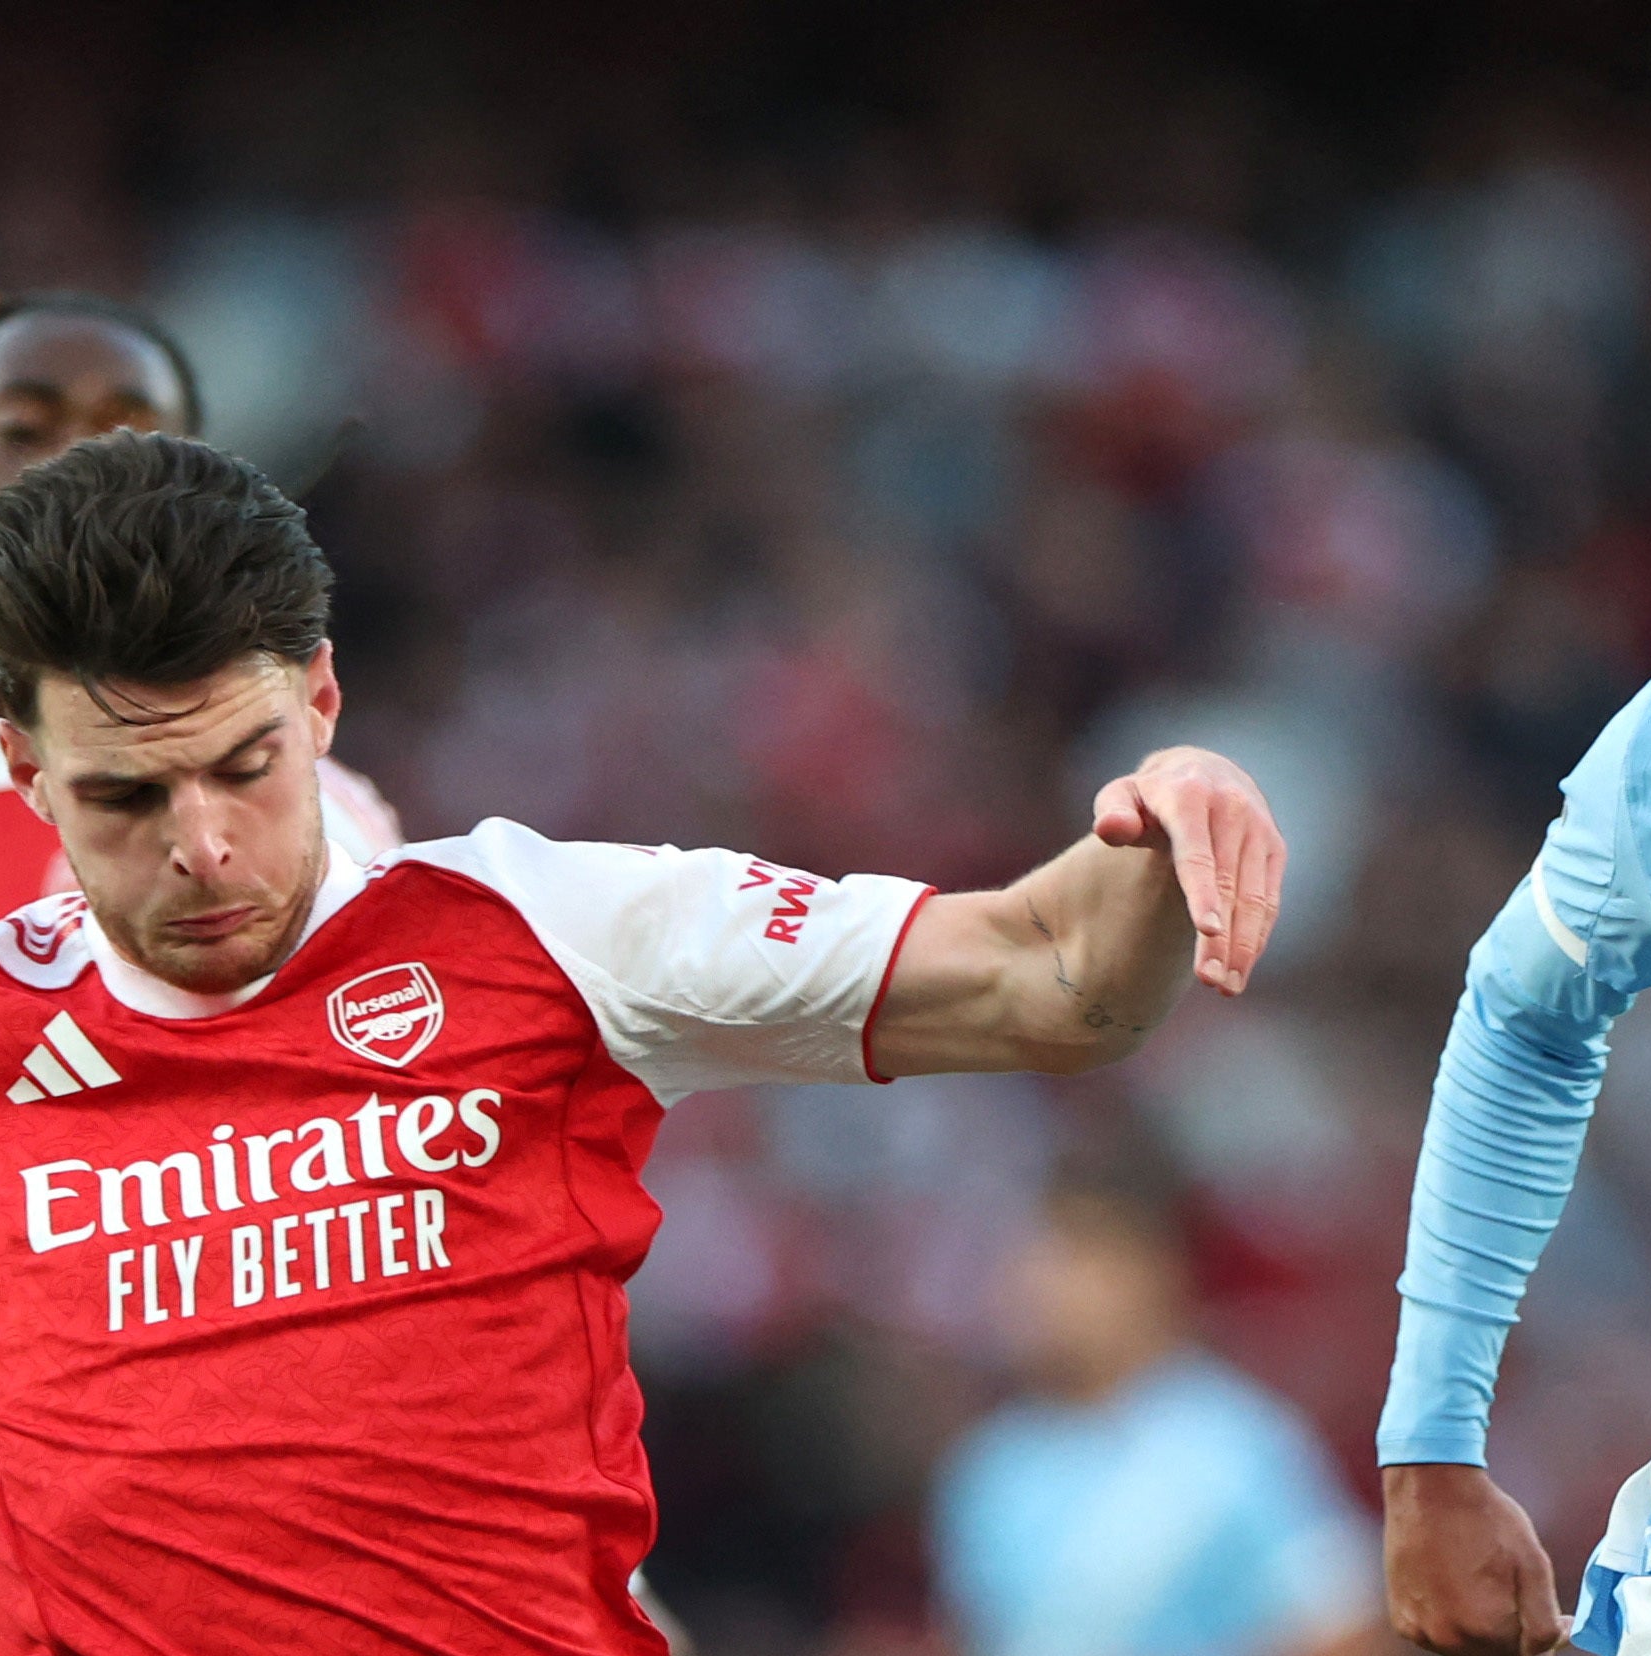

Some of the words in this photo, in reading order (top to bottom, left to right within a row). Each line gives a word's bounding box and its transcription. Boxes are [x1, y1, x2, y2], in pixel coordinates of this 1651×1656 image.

[345, 979, 424, 1020] Arsenal
[19, 1088, 502, 1254] Emirates
[107, 1234, 204, 1332] FLY
[231, 1189, 451, 1308] BETTER
